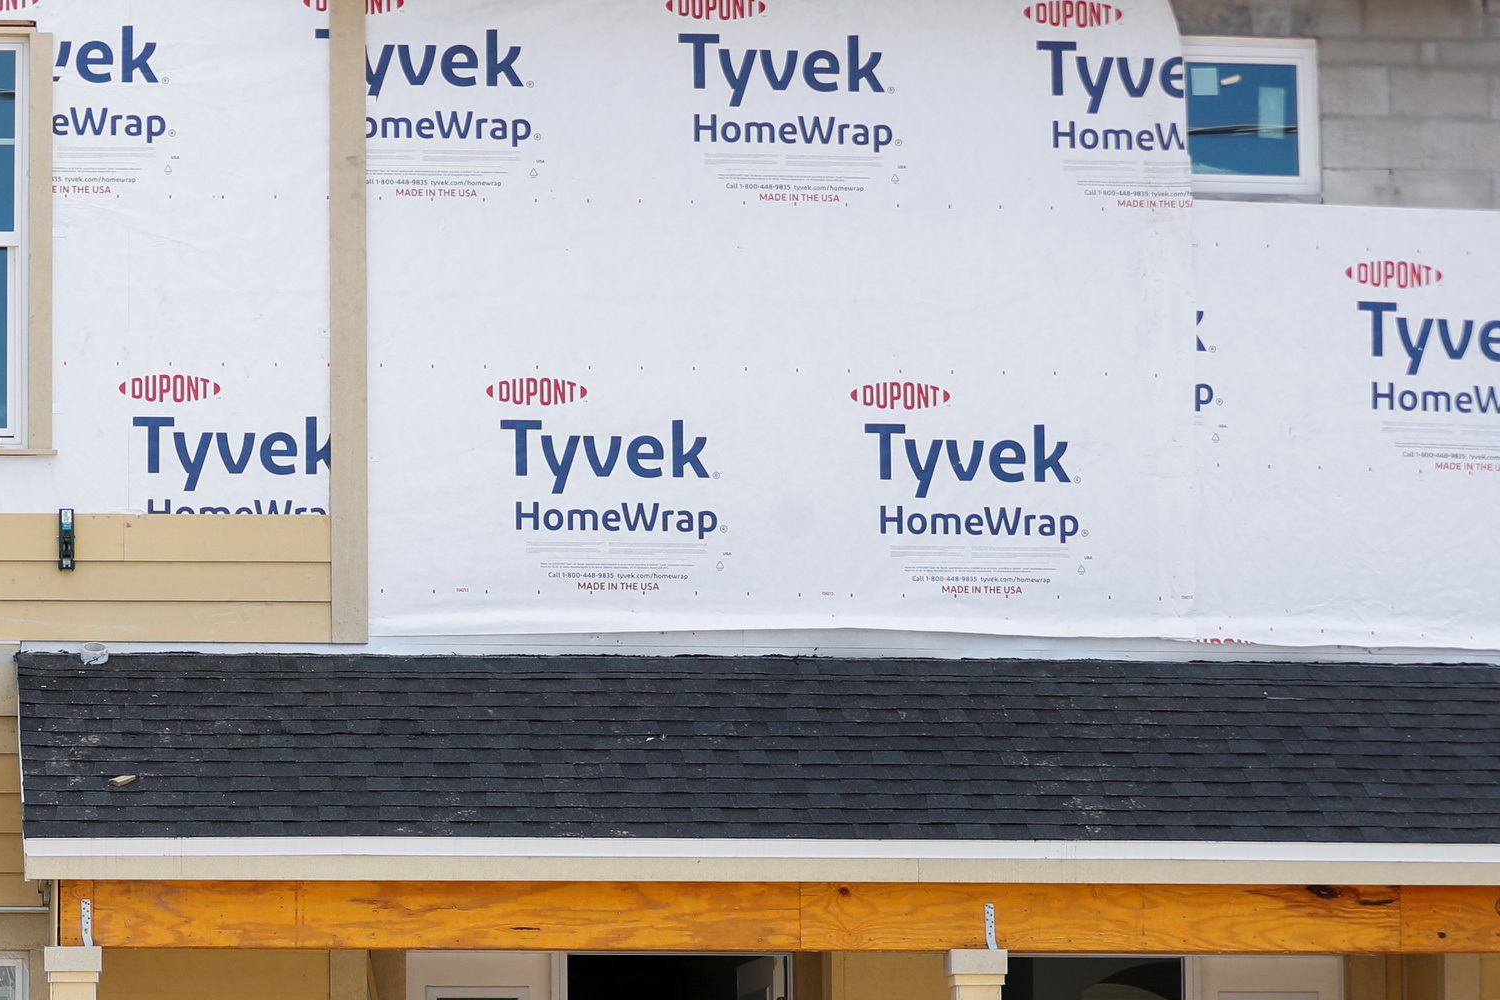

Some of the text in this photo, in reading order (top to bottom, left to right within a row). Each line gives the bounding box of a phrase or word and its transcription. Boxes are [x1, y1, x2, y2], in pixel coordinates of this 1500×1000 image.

[1036, 0, 1111, 28] DUPONT
[315, 29, 523, 100] yvek
[678, 33, 885, 107] Tyvek
[52, 107, 166, 143] eWrap
[365, 111, 531, 147] omeWrap
[694, 114, 892, 153] HomeWrap
[60, 185, 111, 193] IN THE USA
[65, 176, 136, 184] tyvek.com/homewrap
[375, 178, 427, 186] 1-800-448-9835
[431, 179, 501, 187] tyvek.com/homewrap
[396, 188, 477, 197] MADE IN THE USA
[726, 182, 864, 192] Call 1-800-448-9835 tyvek.com/homewrap
[760, 193, 839, 202] MADE IN THE USA
[1358, 261, 1432, 288] DUPONT
[132, 375, 209, 402] DUPONT
[499, 378, 576, 406] DUPONT
[863, 382, 939, 410] DUPONT
[500, 420, 710, 494] Tyvek
[865, 424, 1071, 498] Tyvek
[516, 502, 717, 539] HomeWrap
[880, 505, 1078, 543] HomeWrap
[548, 571, 688, 580] Call 1-800-448-9835 tyvek.com/homewrap
[578, 582, 659, 590] MADE IN THE USA
[912, 574, 1050, 584] Call 1-800-448-9835 tyvek.com/homewrap
[942, 585, 1022, 594] MADE IN THE USA
